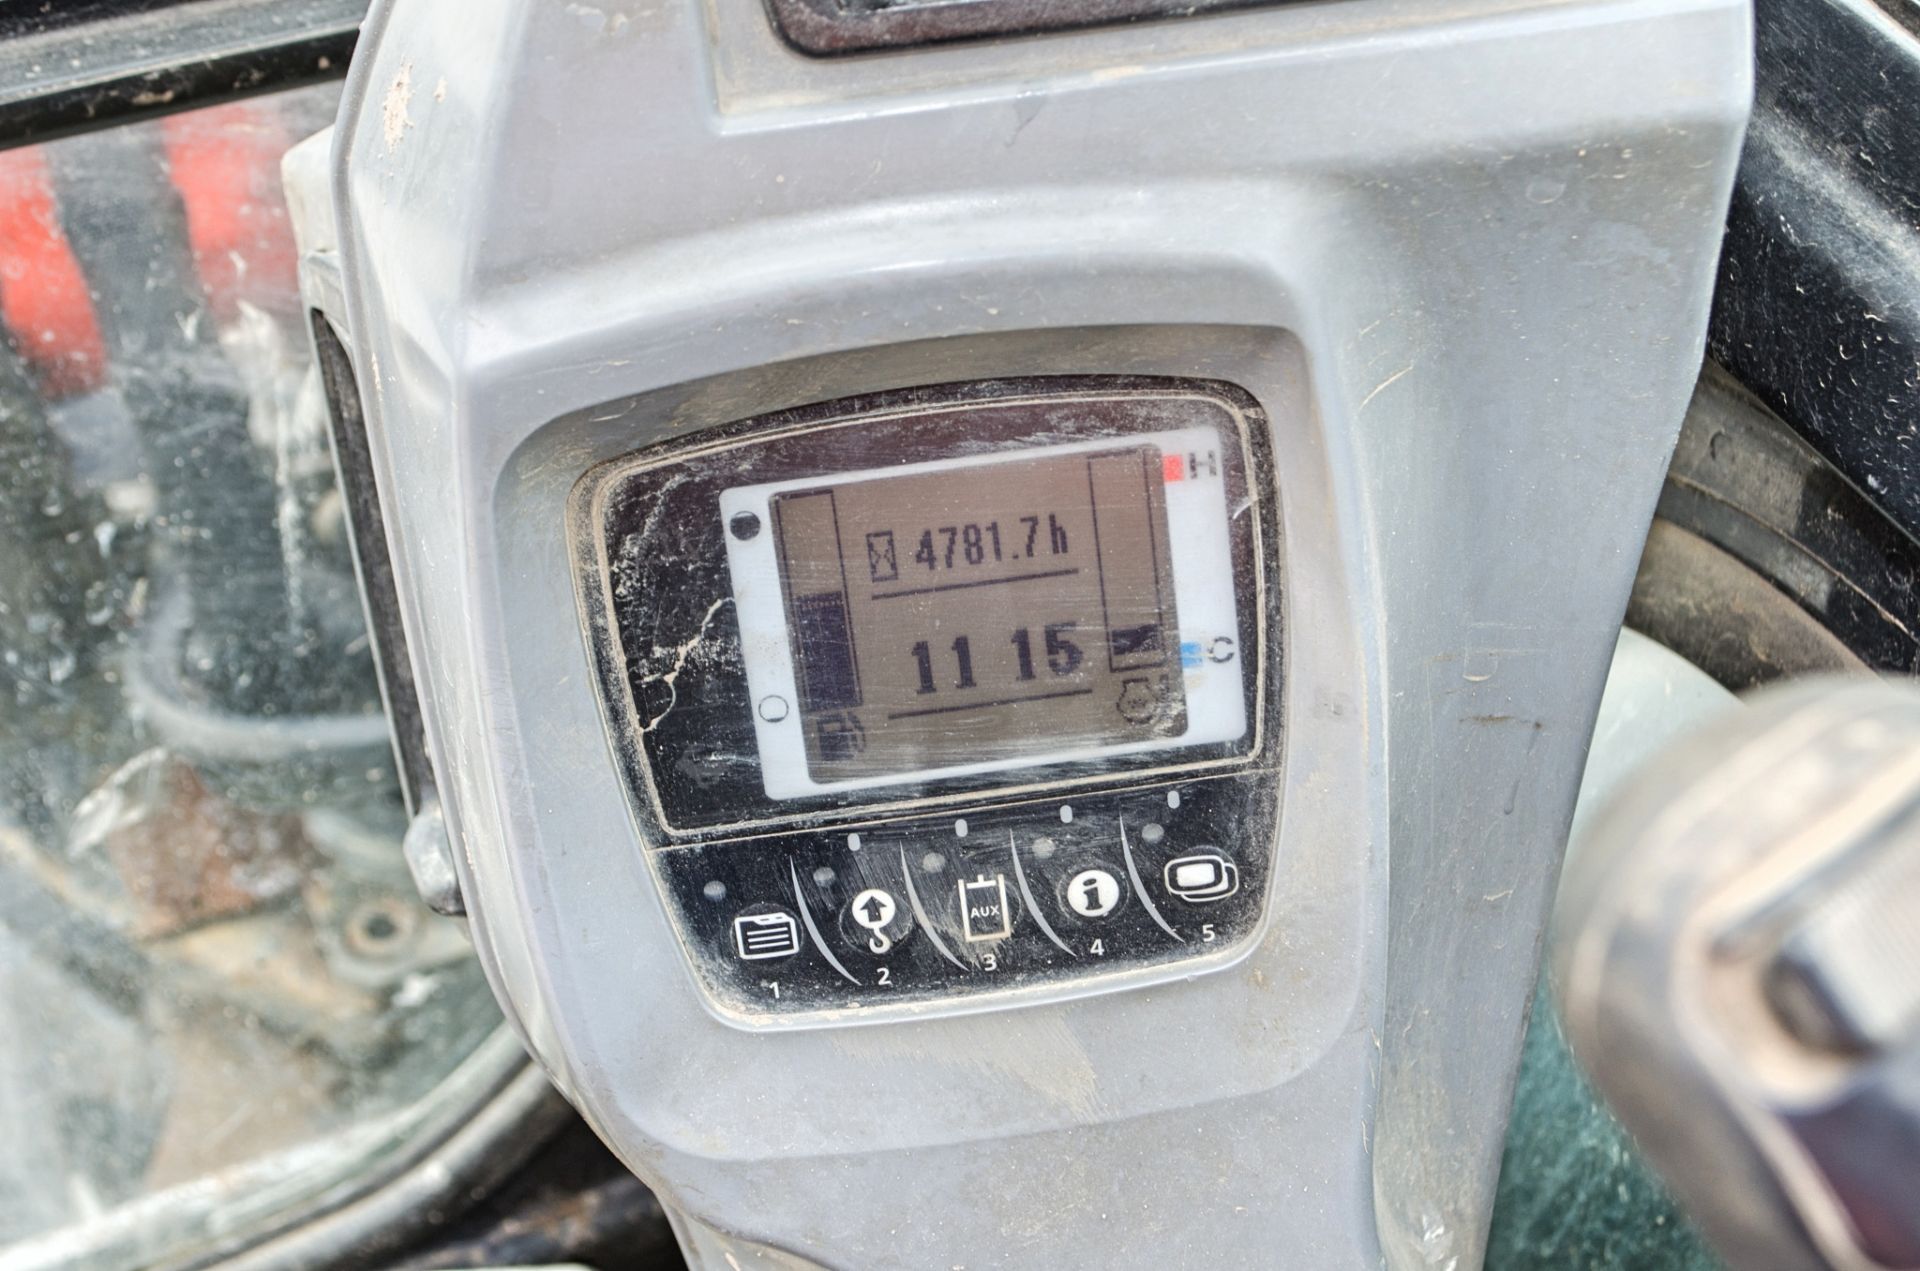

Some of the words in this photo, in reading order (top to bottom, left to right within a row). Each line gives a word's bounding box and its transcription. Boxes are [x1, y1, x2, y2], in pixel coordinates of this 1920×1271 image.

[911, 635, 977, 695] 11
[1010, 621, 1084, 681] 15
[1207, 636, 1235, 663] C
[970, 904, 1001, 919] AUX
[1202, 923, 1216, 943] 5
[1090, 938, 1105, 956] 4
[982, 953, 998, 972] 3
[876, 967, 893, 986] 2
[769, 981, 780, 999] 1
